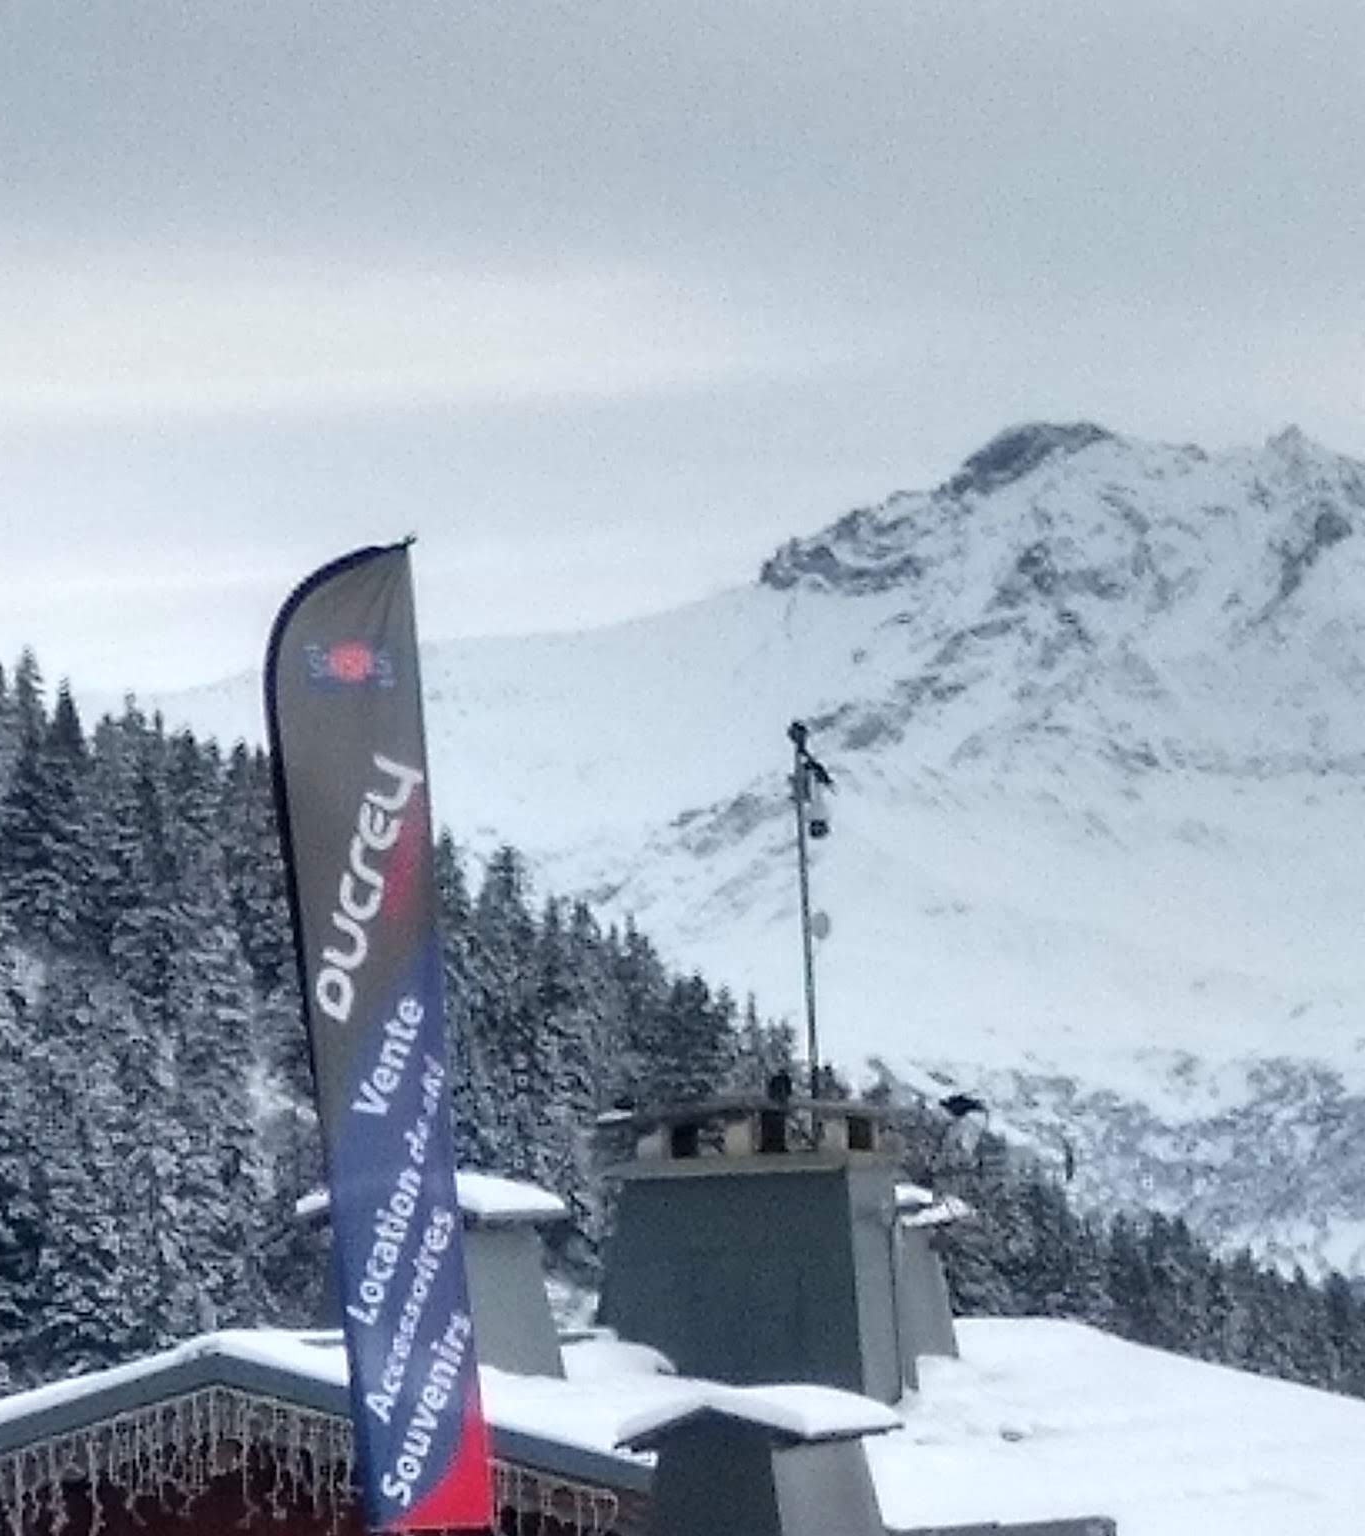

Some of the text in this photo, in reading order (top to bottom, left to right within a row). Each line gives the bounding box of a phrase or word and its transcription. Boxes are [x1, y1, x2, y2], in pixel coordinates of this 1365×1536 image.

[350, 997, 425, 1117] Vente
[346, 1164, 425, 1328] Location
[365, 1204, 456, 1425] Accessoires
[379, 1306, 473, 1509] Souvenirs
